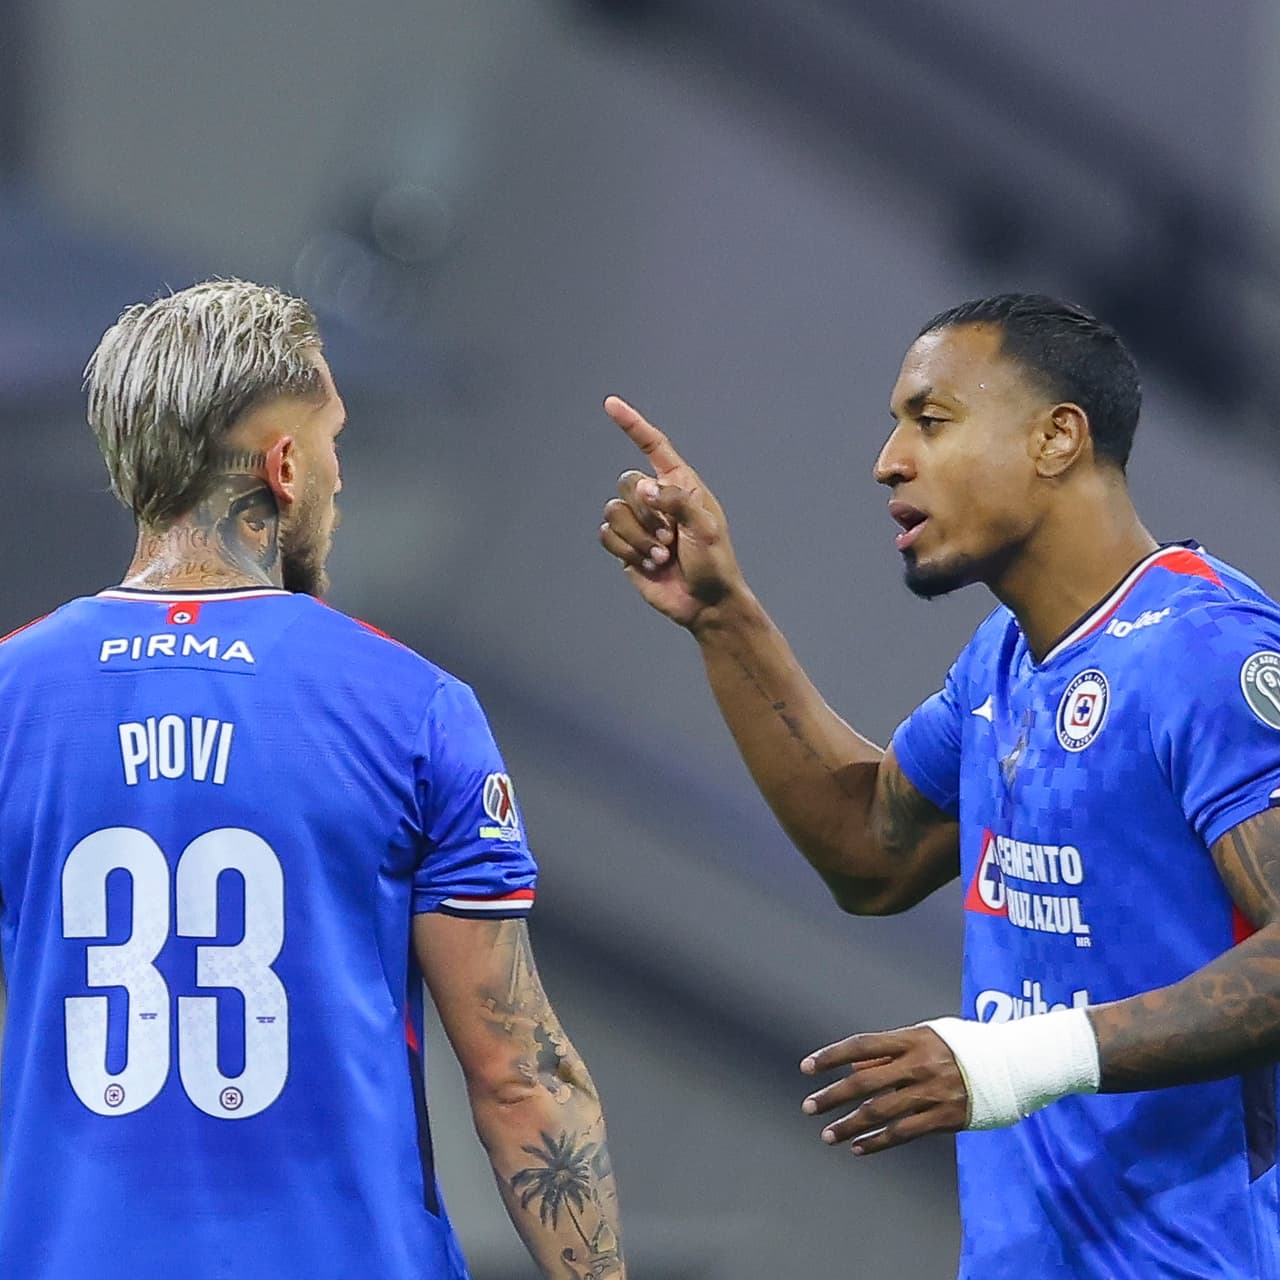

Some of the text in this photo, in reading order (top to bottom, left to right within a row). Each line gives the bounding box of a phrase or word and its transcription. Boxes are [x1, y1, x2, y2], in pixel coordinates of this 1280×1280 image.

[99, 633, 256, 664] PIRMA
[1263, 671, 1277, 688] 9
[118, 714, 235, 786] PIOVI
[996, 835, 1083, 885] CEMENTO
[62, 826, 289, 1119] 33
